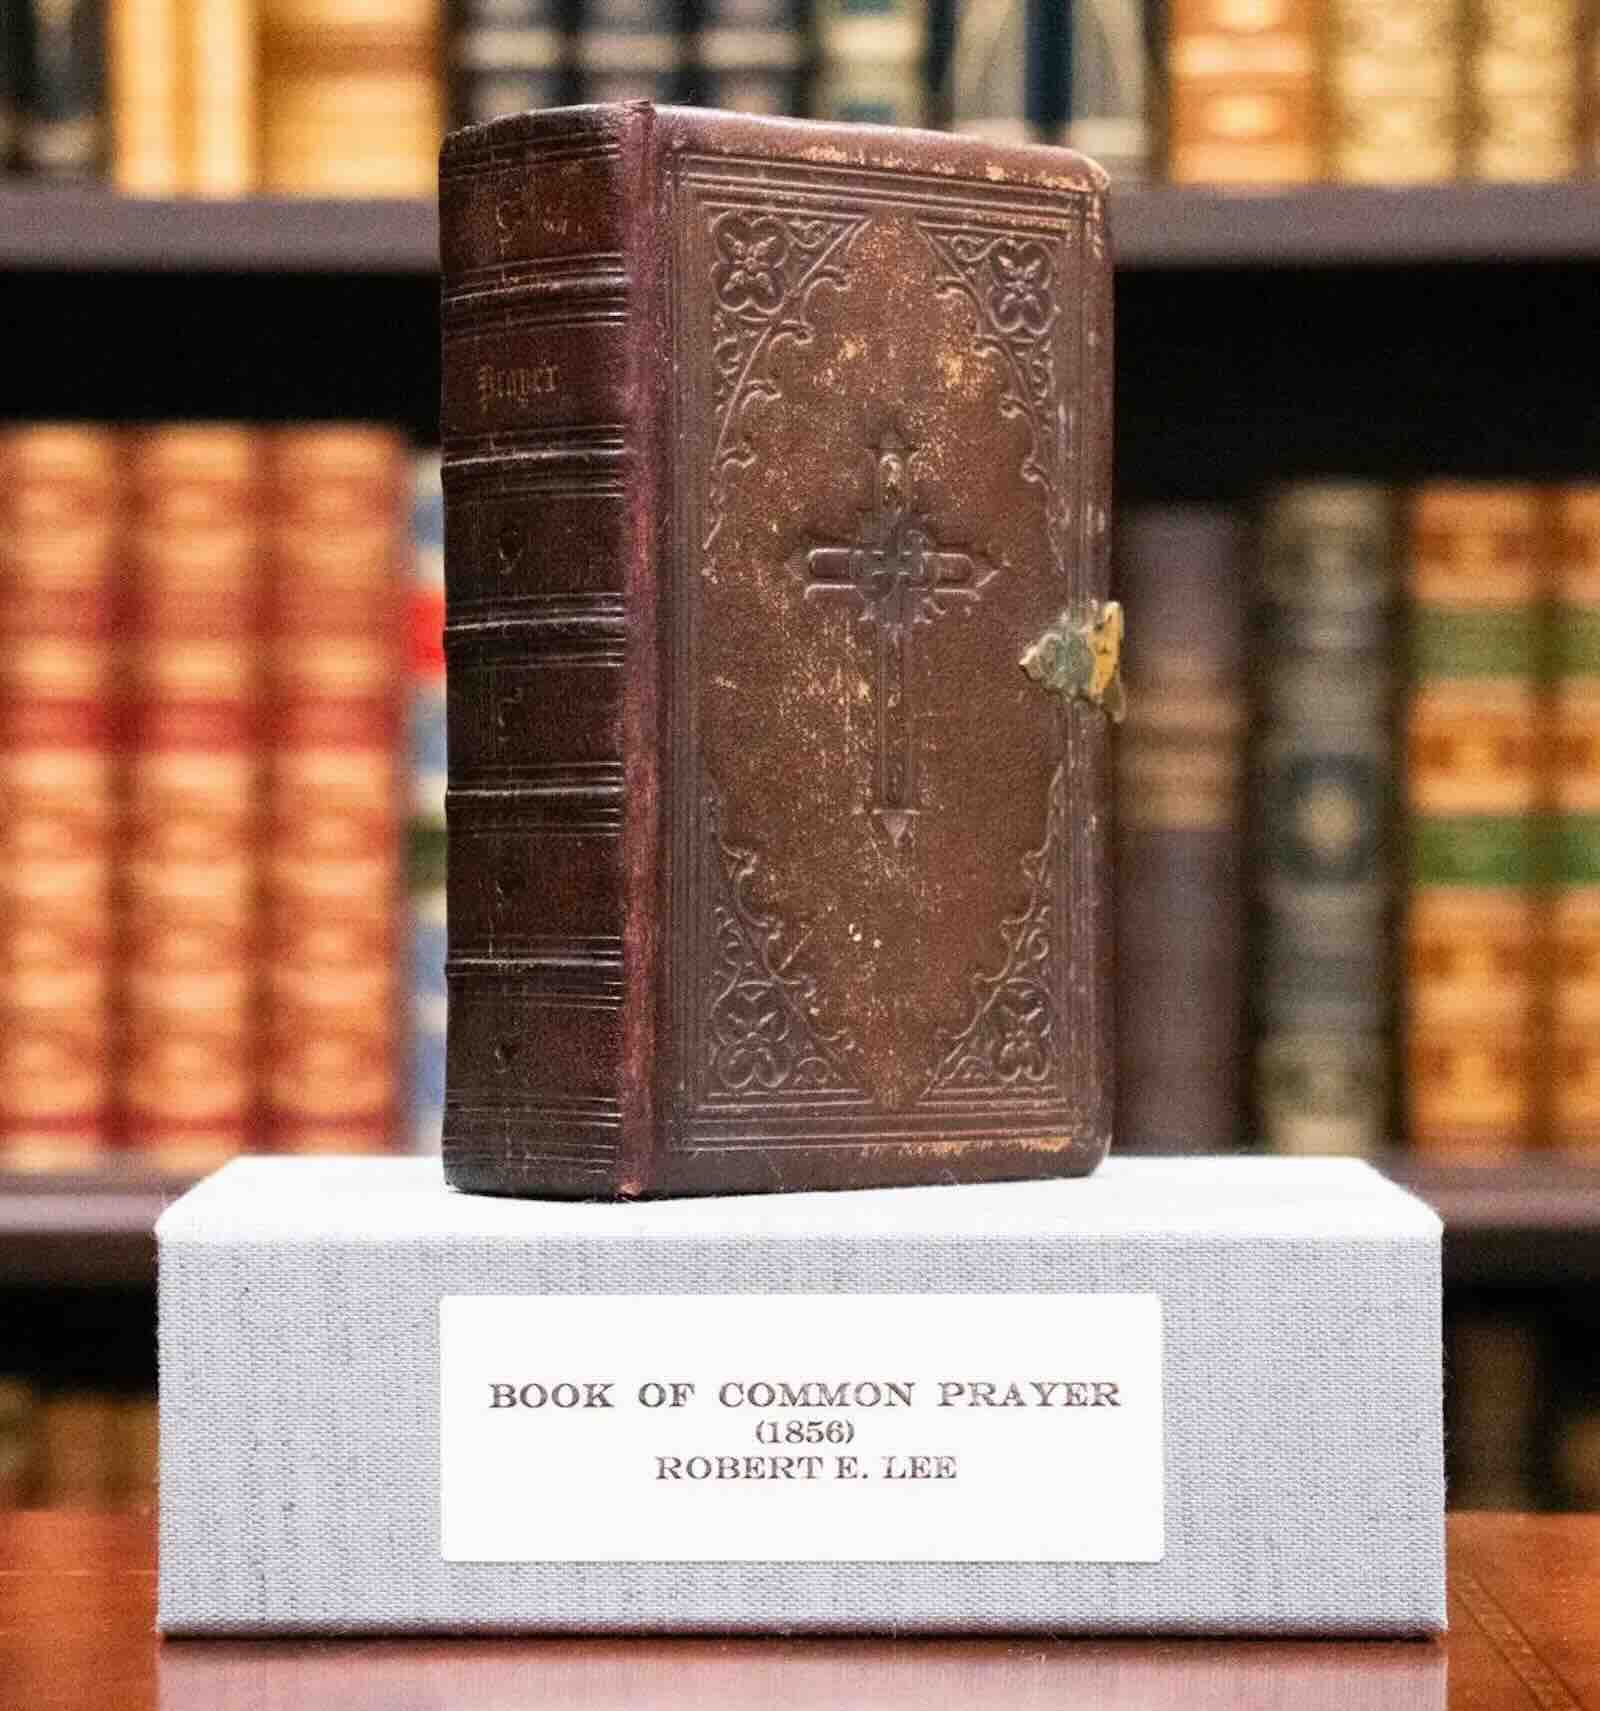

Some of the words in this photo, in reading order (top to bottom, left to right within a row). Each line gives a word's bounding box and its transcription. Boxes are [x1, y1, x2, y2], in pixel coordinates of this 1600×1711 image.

[490, 1383, 614, 1408] BOOK
[639, 1383, 695, 1408] OF
[719, 1382, 915, 1408] COMMON
[938, 1382, 1121, 1407] PRAYER
[756, 1420, 856, 1444] (1856)
[656, 1456, 824, 1480] ROBERT
[836, 1456, 869, 1480] E.
[884, 1456, 957, 1480] LEE
